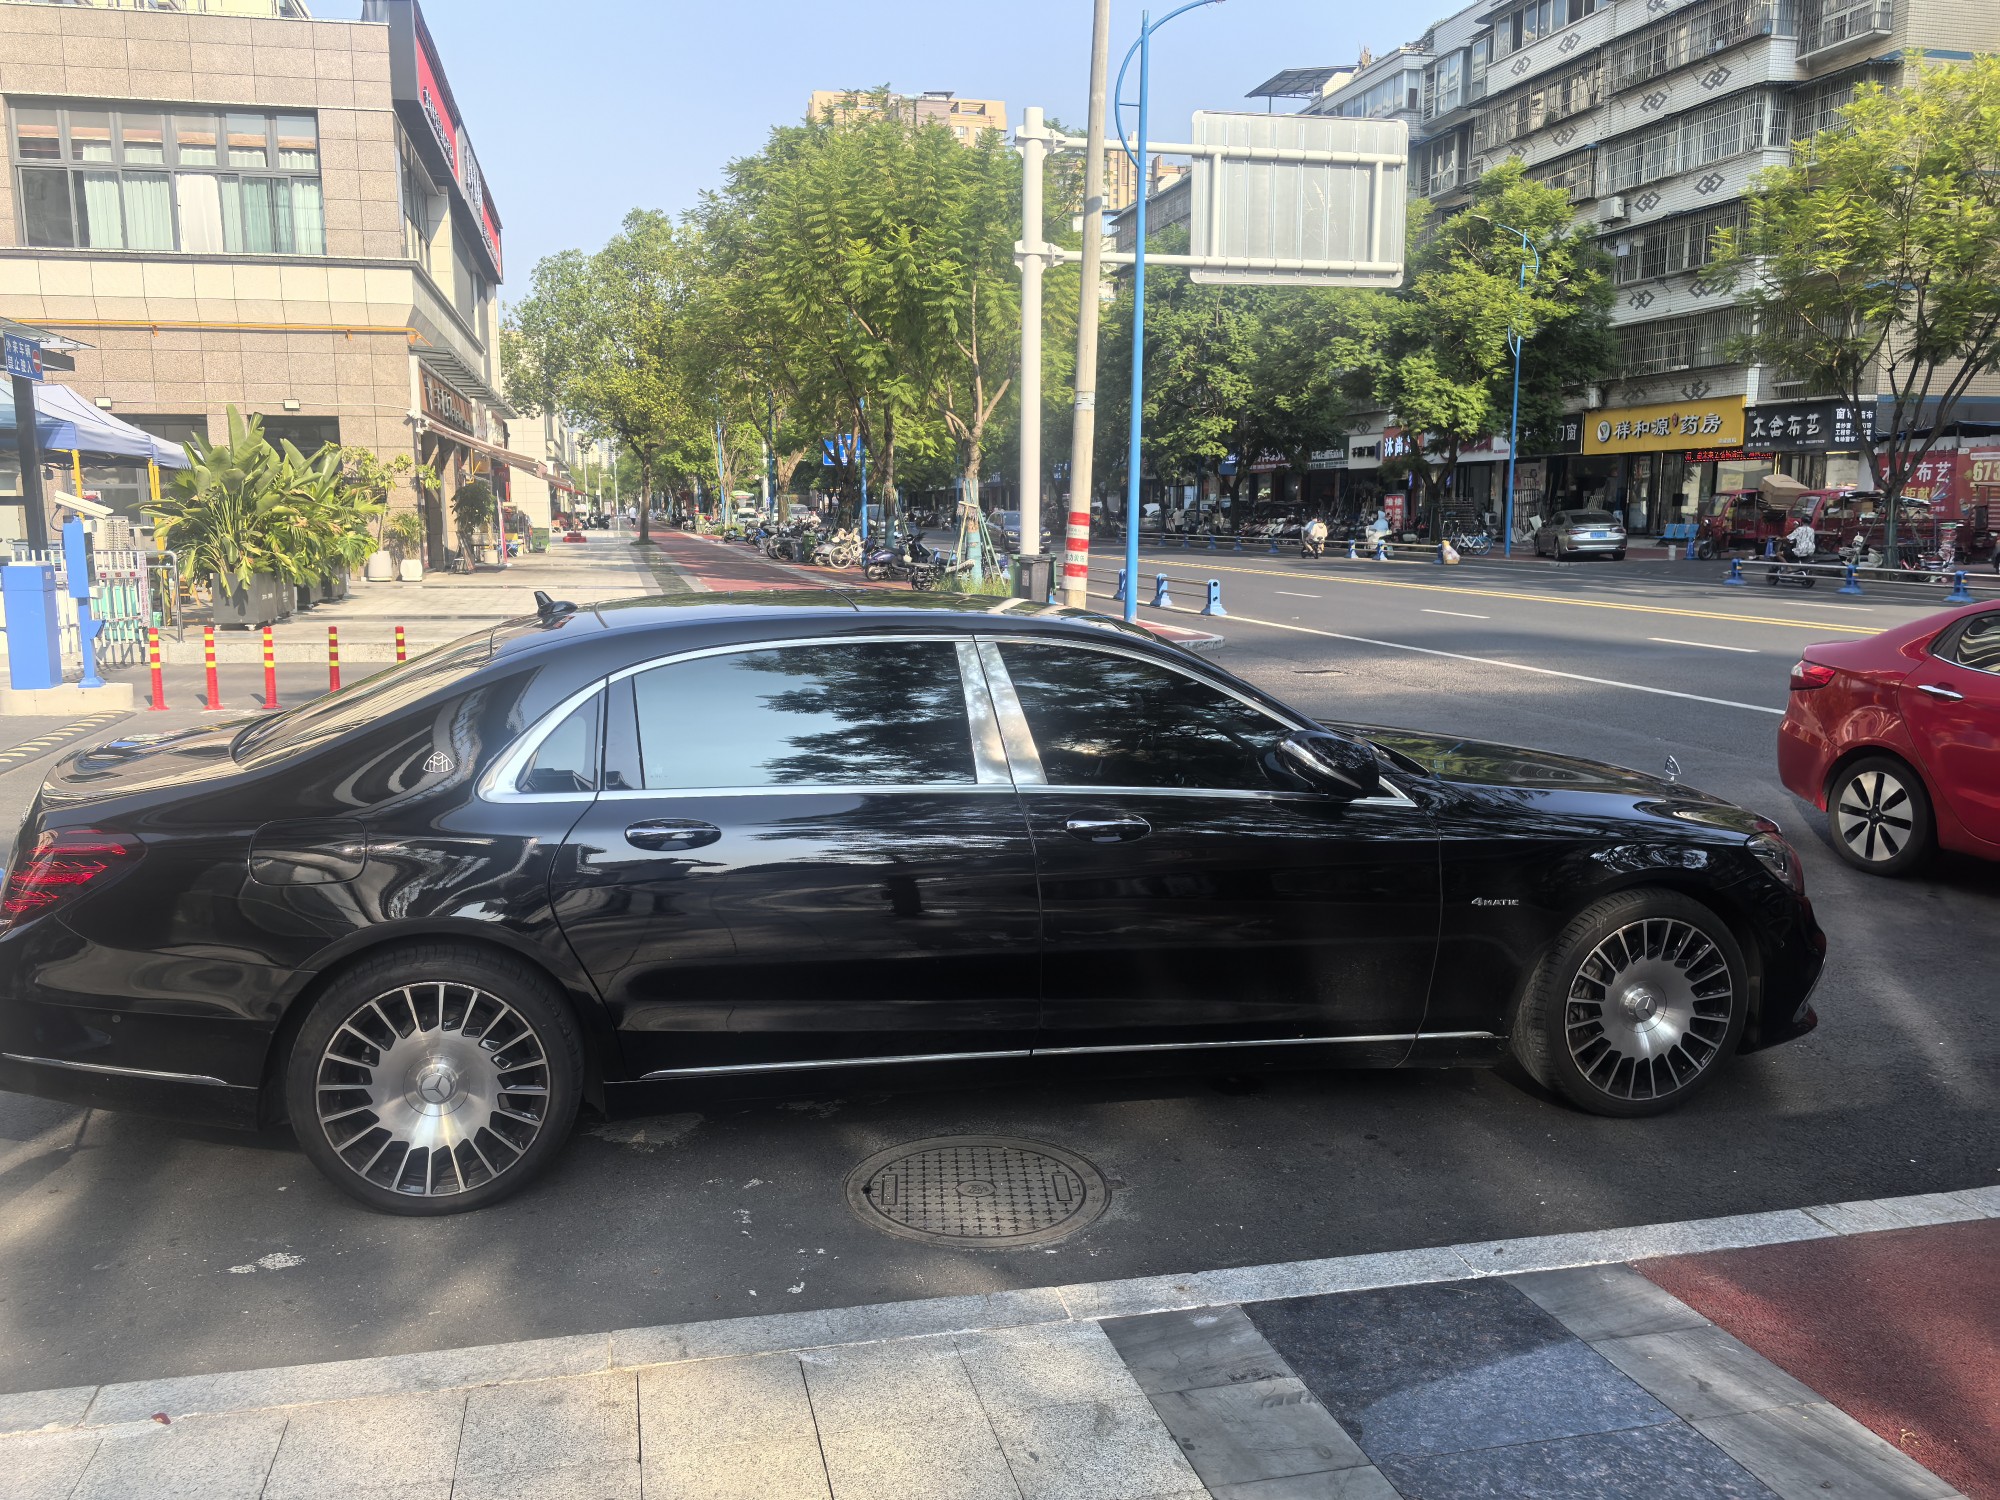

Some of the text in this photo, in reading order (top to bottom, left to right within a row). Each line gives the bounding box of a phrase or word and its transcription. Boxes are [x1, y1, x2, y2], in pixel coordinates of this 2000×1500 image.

[6, 338, 31, 358] 外来车辆
[8, 355, 33, 374] 禁止驶入
[1471, 897, 1520, 906] 4MATIC
